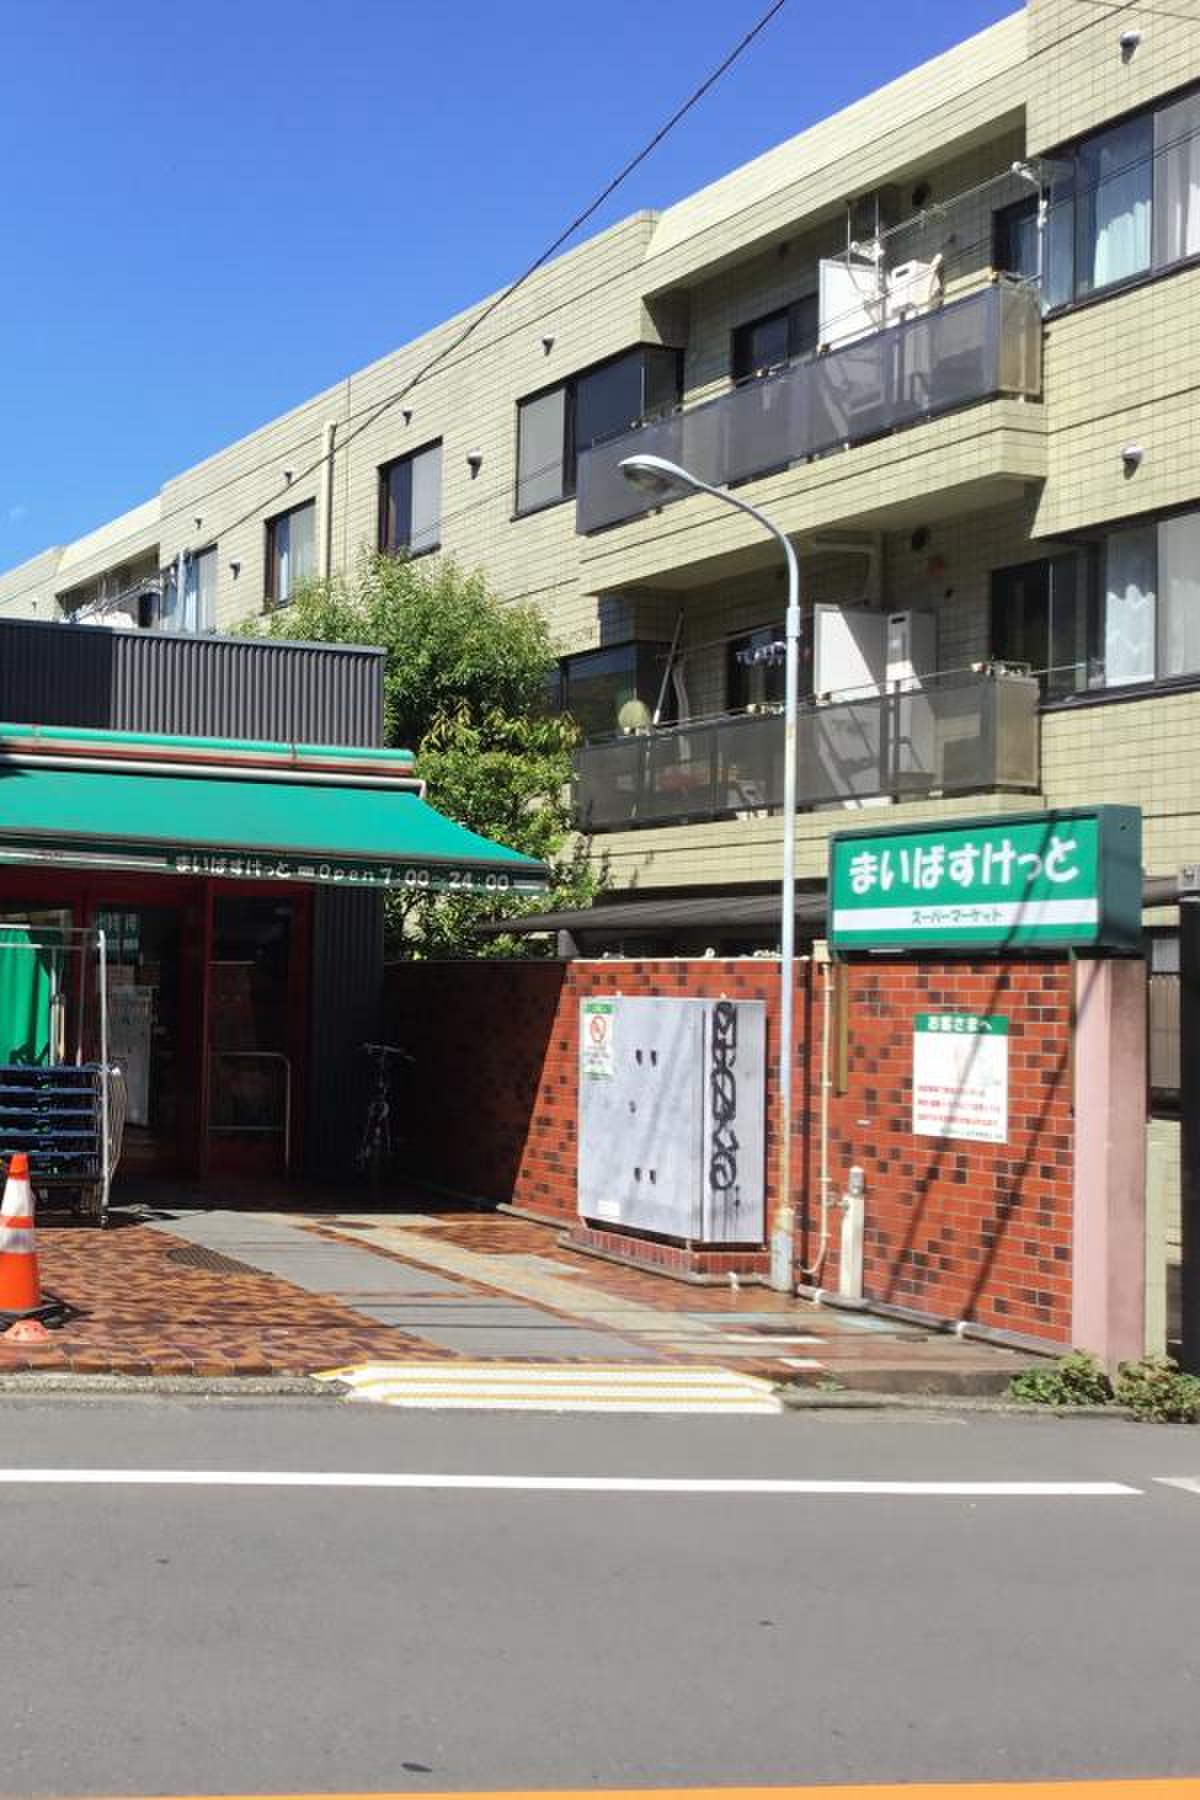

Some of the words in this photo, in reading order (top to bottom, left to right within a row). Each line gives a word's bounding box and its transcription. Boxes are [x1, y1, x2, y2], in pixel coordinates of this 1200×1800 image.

[319, 863, 375, 881] Open
[849, 836, 1080, 894] まいばすけっと
[912, 907, 1002, 925] スーパーマーケット
